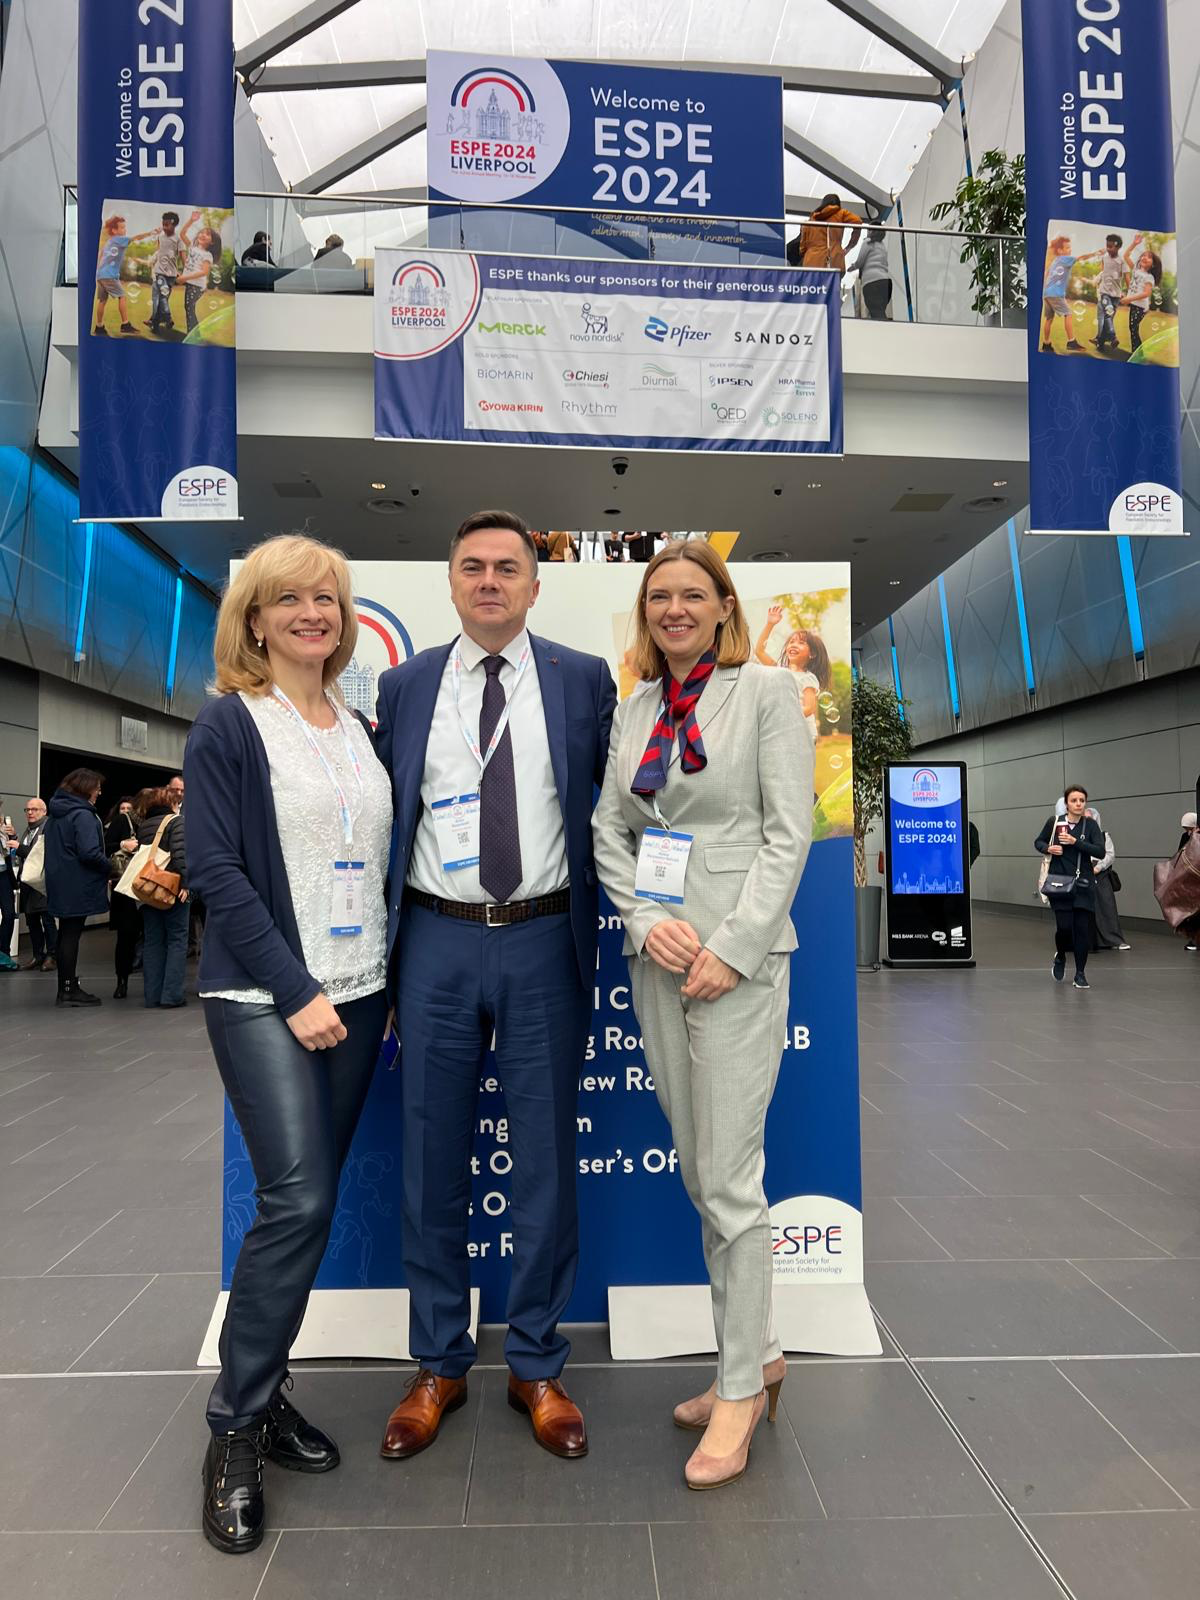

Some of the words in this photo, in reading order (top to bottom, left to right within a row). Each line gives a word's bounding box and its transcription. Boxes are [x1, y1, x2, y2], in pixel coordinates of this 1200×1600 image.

[1076, 0, 1122, 56] 20
[117, 67, 132, 88] to
[590, 87, 680, 113] Welcome
[685, 97, 706, 114] to
[1060, 92, 1075, 112] to
[138, 43, 184, 177] ESPE
[115, 92, 132, 177] Welcome
[593, 117, 713, 163] ESPE
[1079, 70, 1126, 200] ESPE
[450, 140, 491, 157] ESPE
[494, 143, 536, 160] 2024
[1060, 115, 1077, 199] Welcome
[451, 156, 536, 175] LIVERPOOL
[592, 163, 712, 207] 2024
[489, 268, 524, 280] ESPE
[527, 269, 571, 283] thanks
[574, 274, 596, 285] our
[599, 275, 658, 290] sponsors
[661, 277, 680, 289] for
[683, 278, 713, 290] their
[716, 282, 775, 294] generous
[778, 283, 827, 295] support
[391, 306, 417, 317] ESPE
[419, 307, 446, 318] 2024
[391, 316, 446, 327] LIVERPOOL
[569, 333, 591, 342] novo
[670, 325, 712, 347] Pfizer
[734, 331, 813, 346] SANDOZ
[575, 370, 609, 382] Chiesi
[641, 375, 678, 387] Diurnal
[717, 377, 753, 387] IPSEN
[517, 404, 544, 413] KIRIN
[561, 400, 618, 415] Rhythm
[716, 406, 747, 421] QED
[781, 413, 818, 422] SOLENO
[178, 478, 227, 496] ESPE
[1125, 495, 1172, 512] ESPE
[895, 818, 943, 829] Welcome
[945, 819, 957, 829] to
[898, 834, 926, 844] ESPE
[927, 834, 957, 844] 2024!
[795, 1257, 820, 1266] Society
[820, 1256, 830, 1265] for
[797, 1265, 843, 1275] Endocrinology
